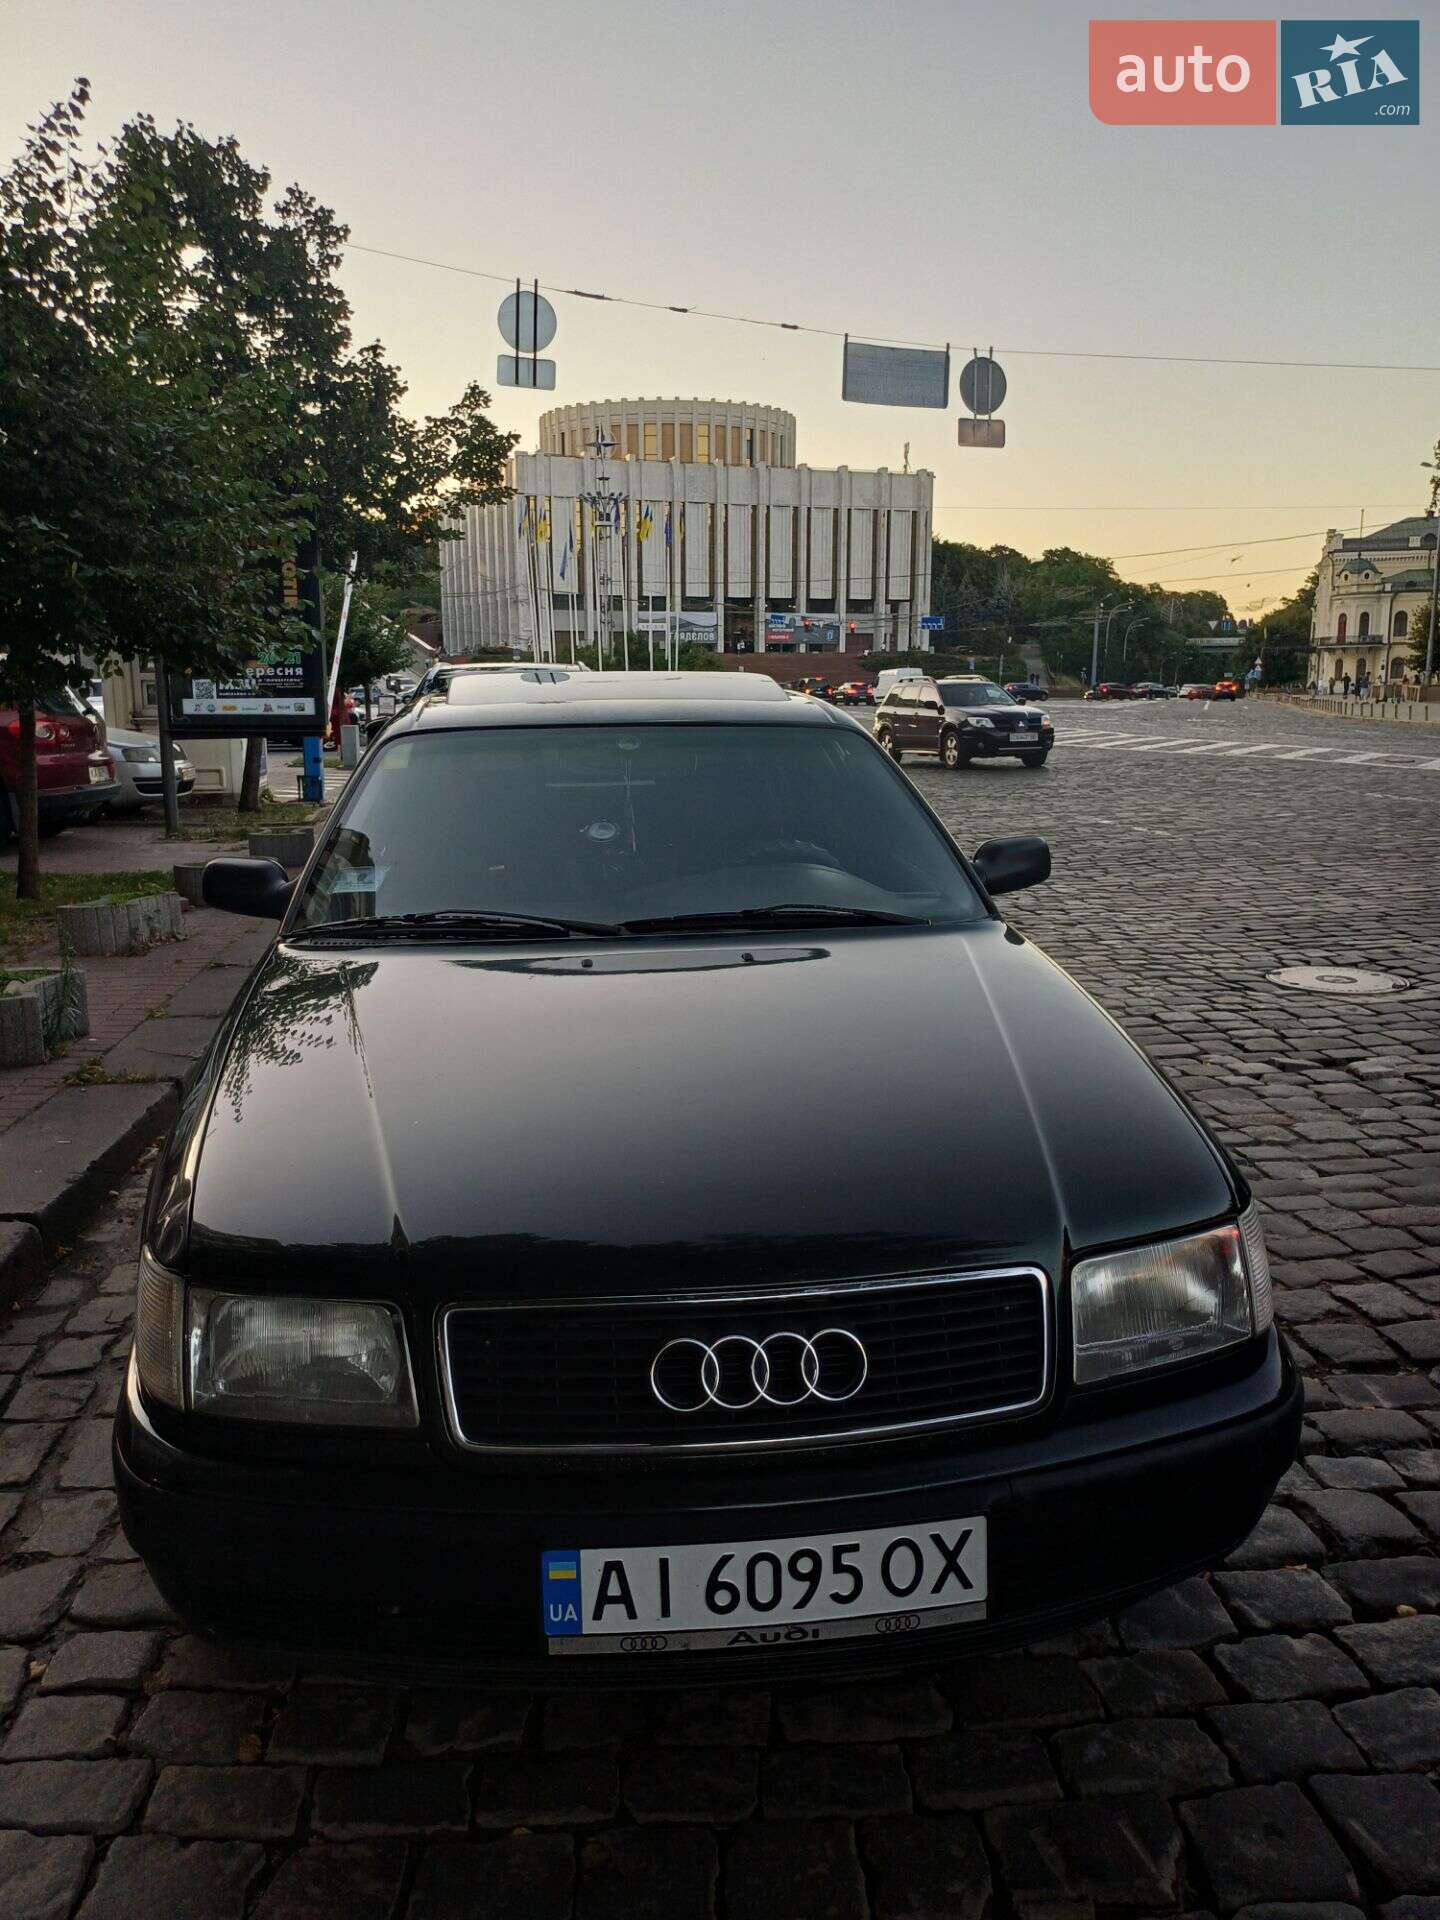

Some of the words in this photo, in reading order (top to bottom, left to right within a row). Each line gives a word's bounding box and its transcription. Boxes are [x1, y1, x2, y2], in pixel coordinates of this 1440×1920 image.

[237, 667, 304, 679] ересня
[592, 1557, 671, 1621] AI
[704, 1542, 864, 1616] 6095
[880, 1528, 975, 1598] OX
[549, 1604, 578, 1623] UA
[727, 1625, 820, 1646] Audi
